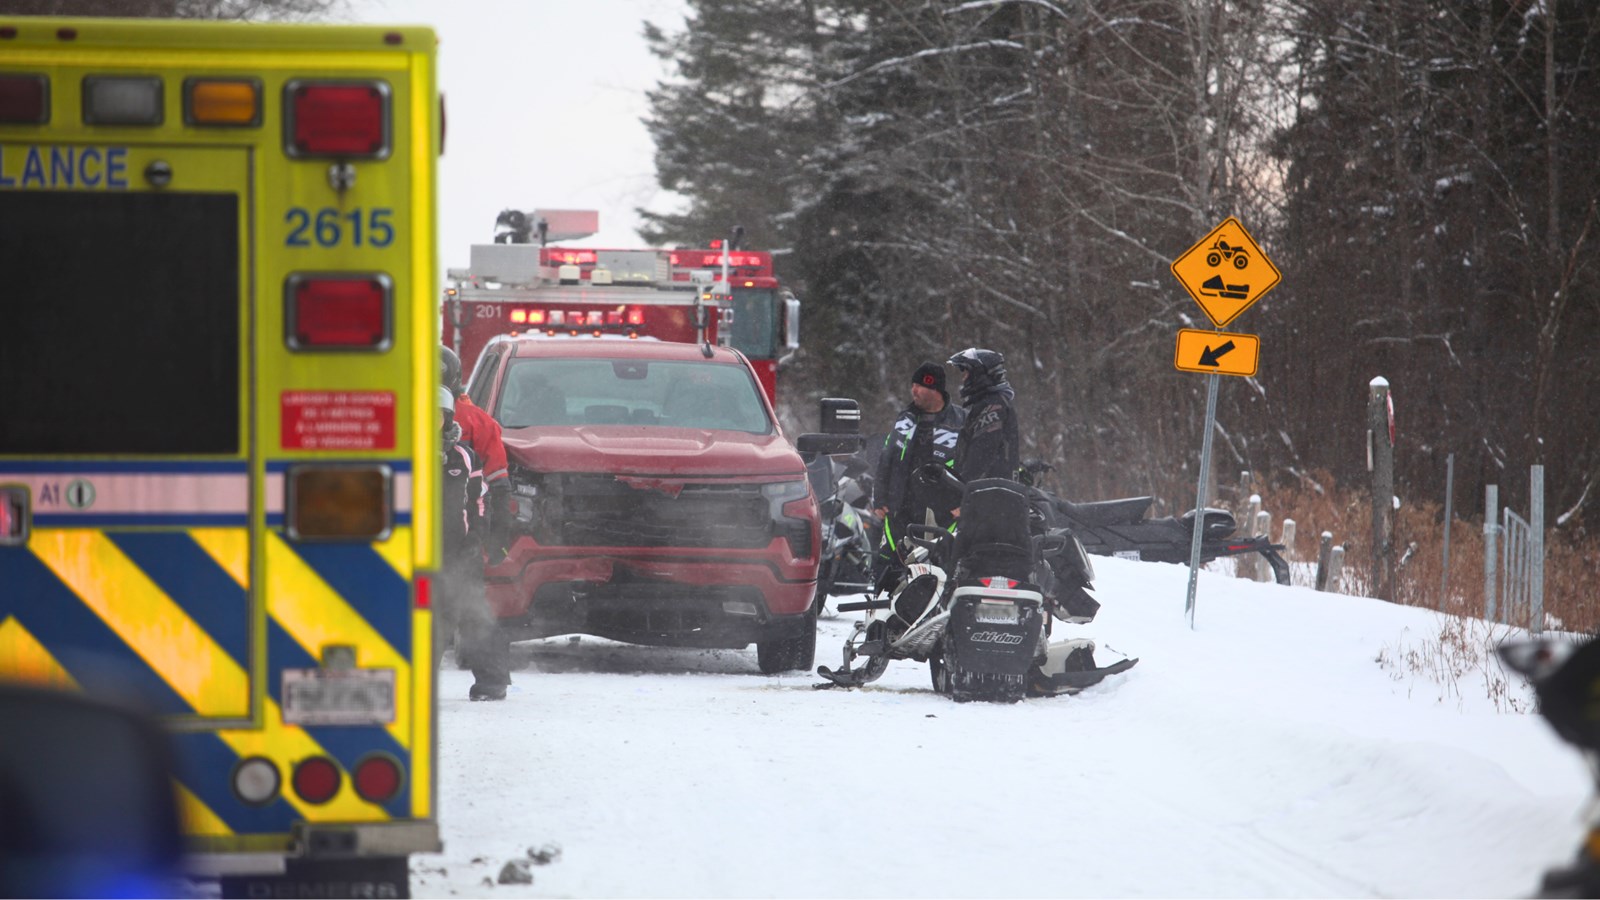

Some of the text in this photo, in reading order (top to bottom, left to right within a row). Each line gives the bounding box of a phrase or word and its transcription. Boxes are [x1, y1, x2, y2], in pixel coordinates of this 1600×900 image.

[0, 145, 127, 187] LANCE
[285, 207, 394, 248] 2615
[476, 304, 501, 318] 201
[39, 482, 60, 505] A1
[971, 631, 1023, 645] ski-doo
